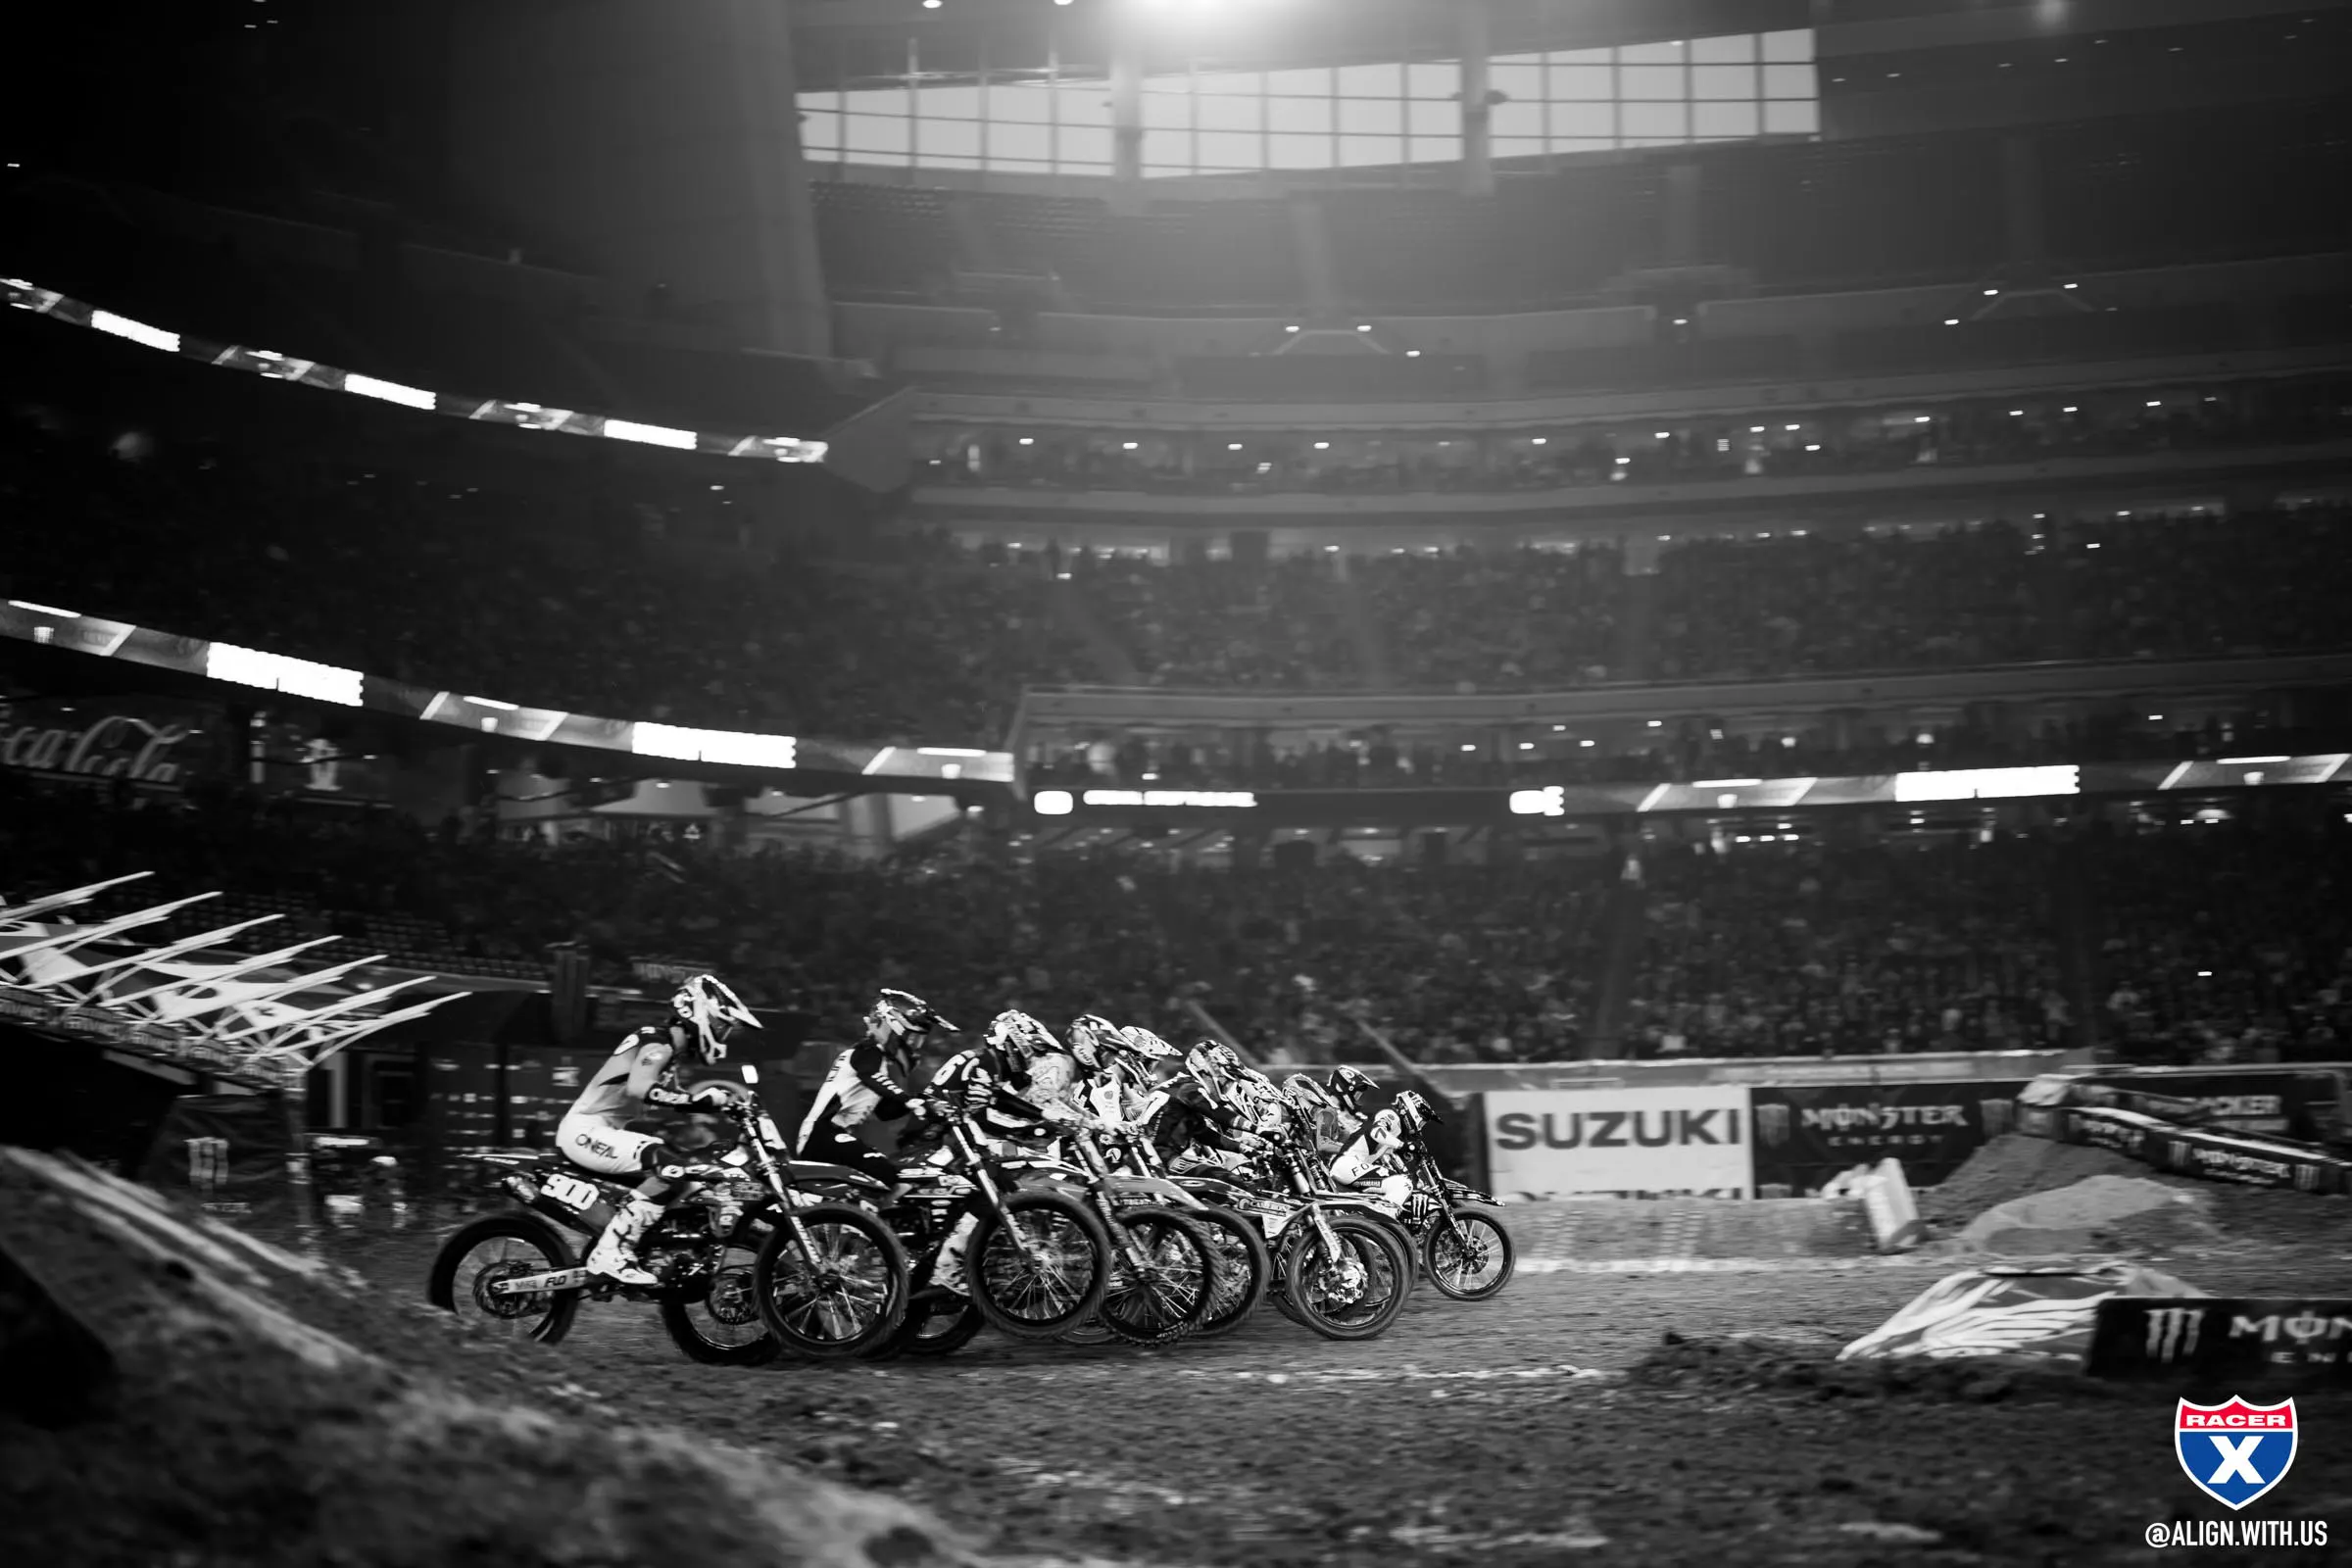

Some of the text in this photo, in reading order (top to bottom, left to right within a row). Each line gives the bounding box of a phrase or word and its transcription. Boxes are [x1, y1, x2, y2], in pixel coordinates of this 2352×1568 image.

[1496, 1108, 1740, 1151] SUZUKI
[1800, 1102, 1970, 1132] MONSTER
[541, 1173, 600, 1211] 900
